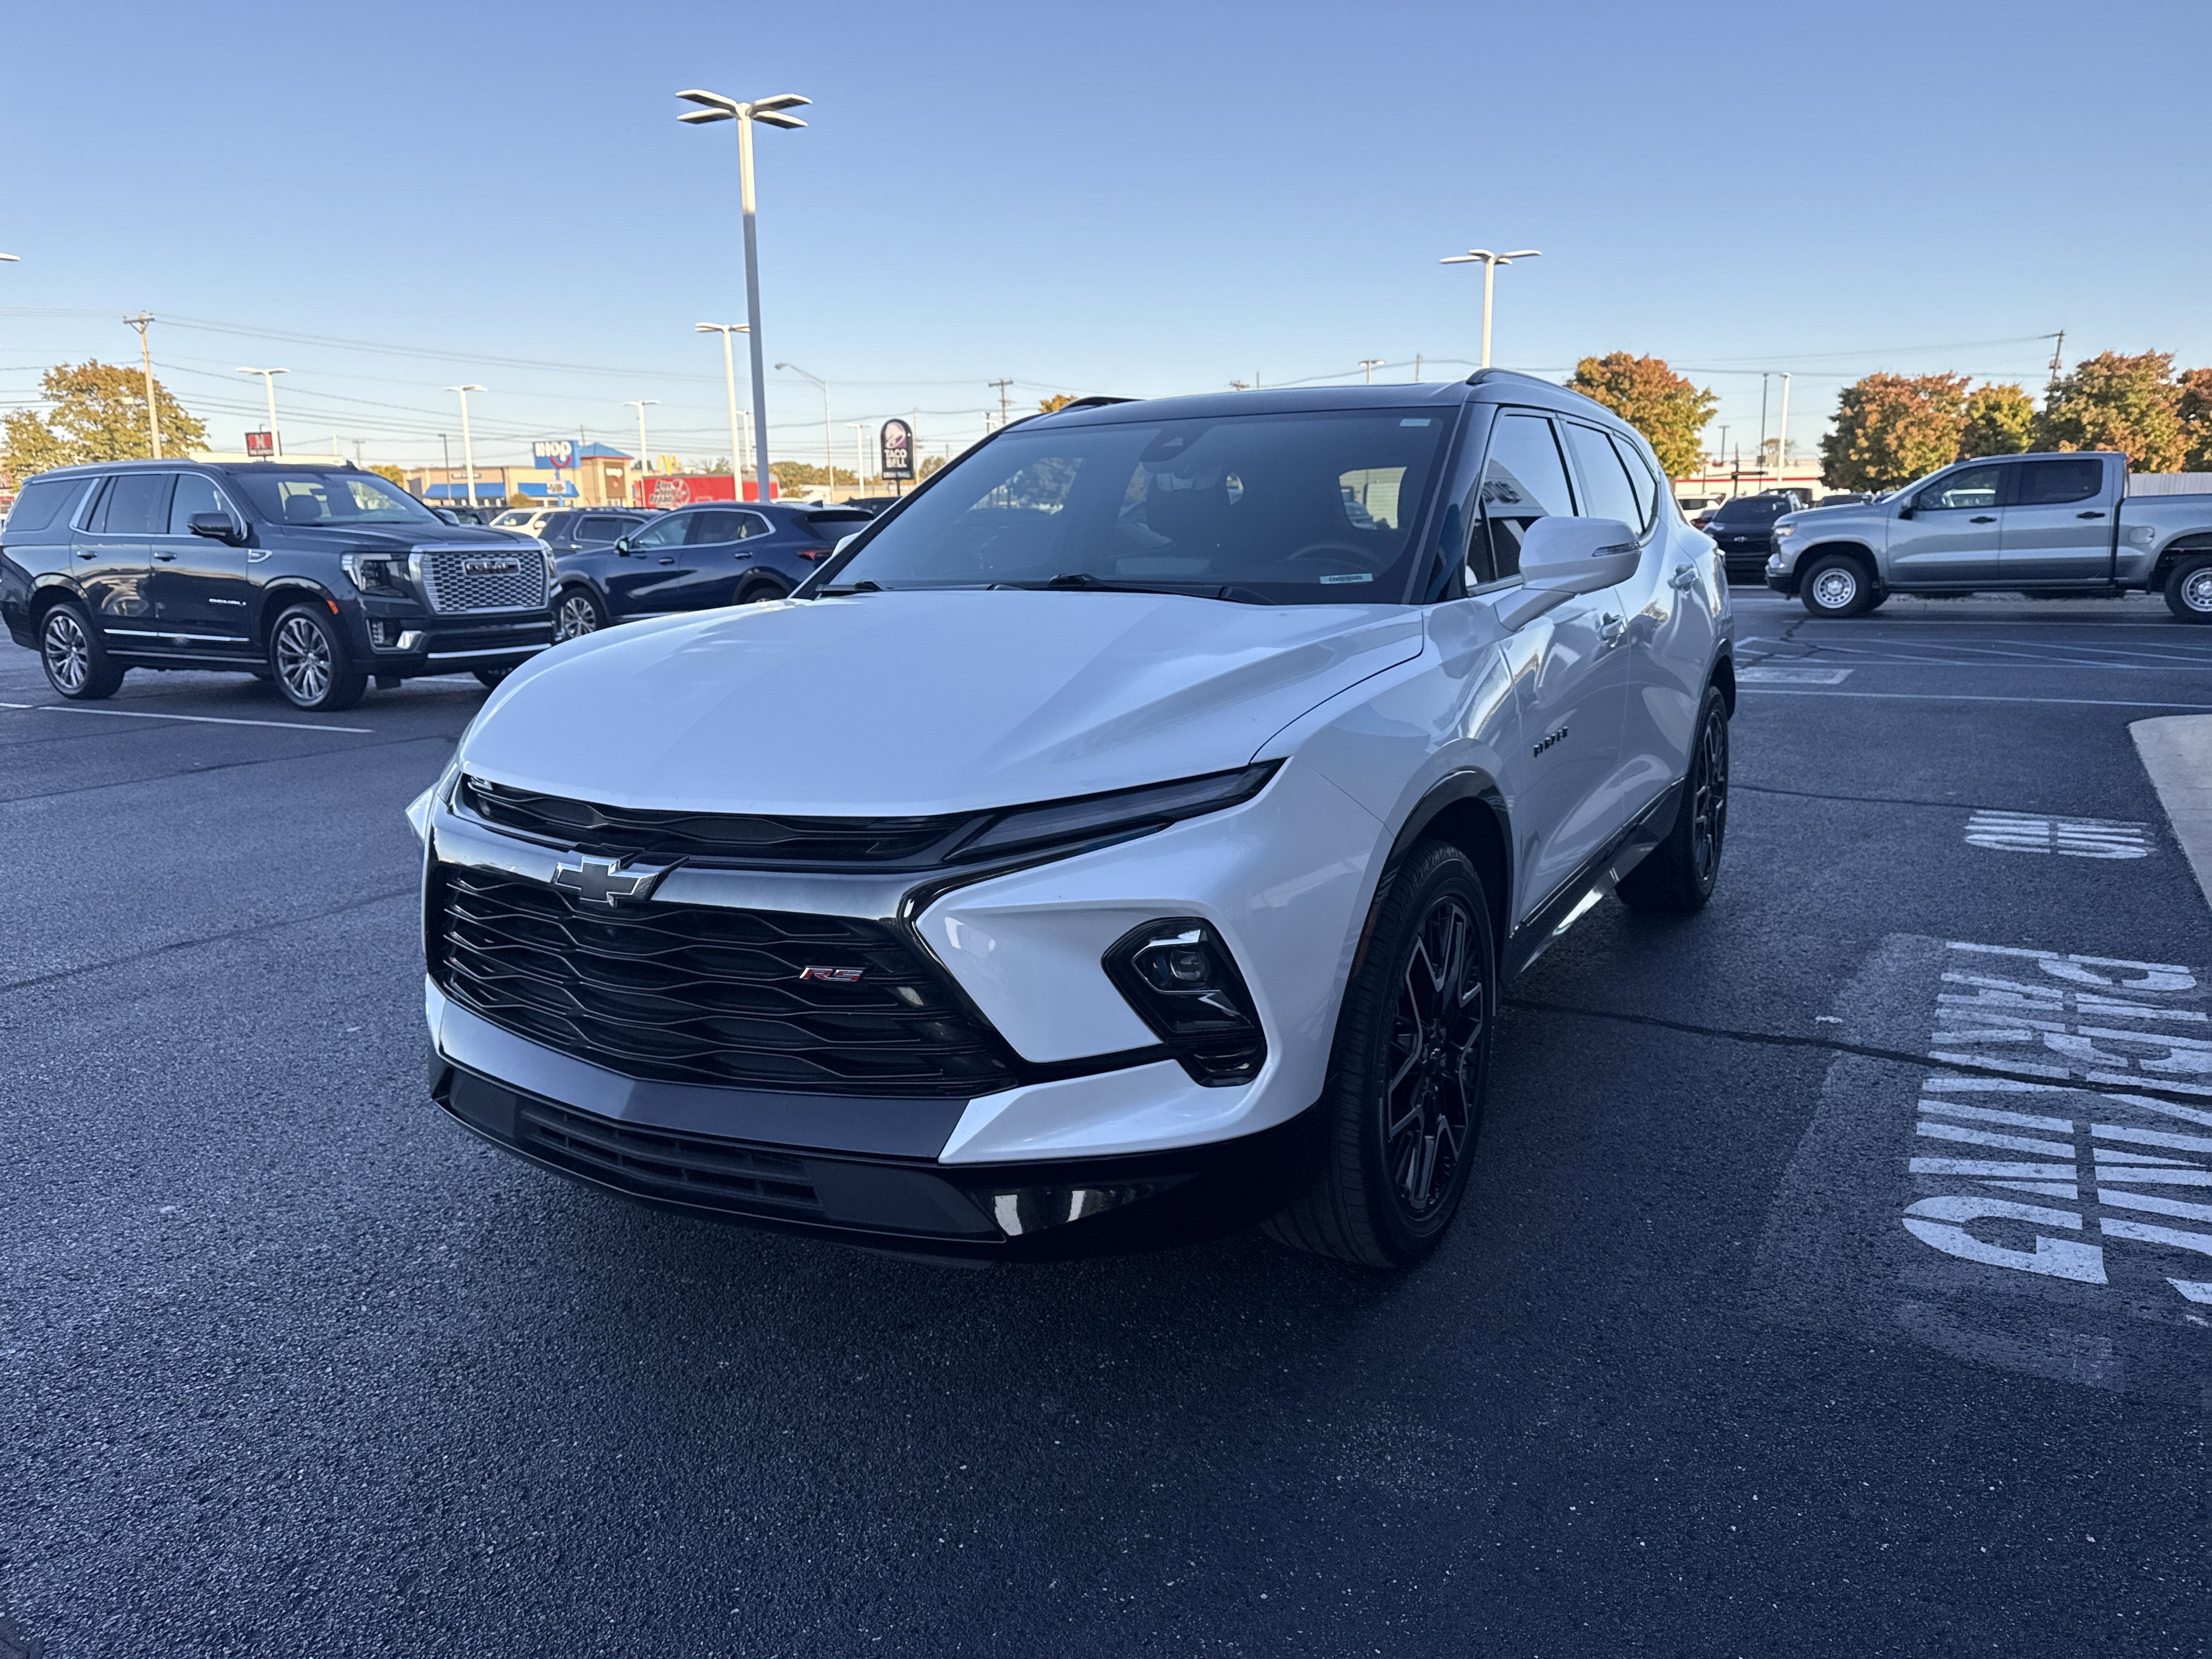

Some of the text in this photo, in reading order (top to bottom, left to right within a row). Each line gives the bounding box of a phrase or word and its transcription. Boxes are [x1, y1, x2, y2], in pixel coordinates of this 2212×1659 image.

[884, 448, 907, 459] TACO
[886, 458, 907, 468] BELL
[799, 967, 863, 982] RS
